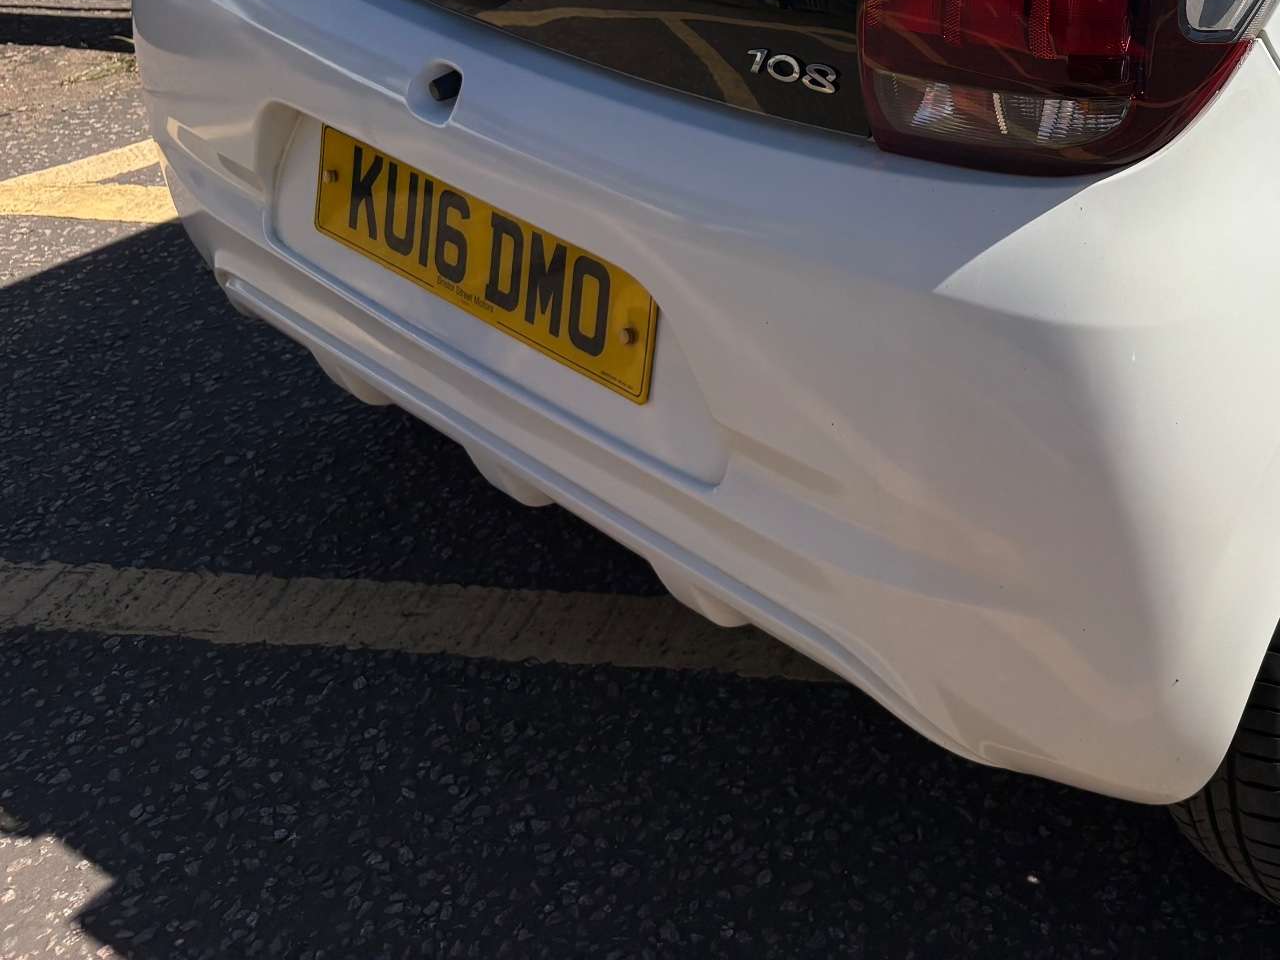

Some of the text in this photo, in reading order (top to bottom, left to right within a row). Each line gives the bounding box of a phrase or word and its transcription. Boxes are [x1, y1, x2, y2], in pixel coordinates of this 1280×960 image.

[747, 49, 836, 94] 108
[349, 146, 611, 357] KU16 DMO
